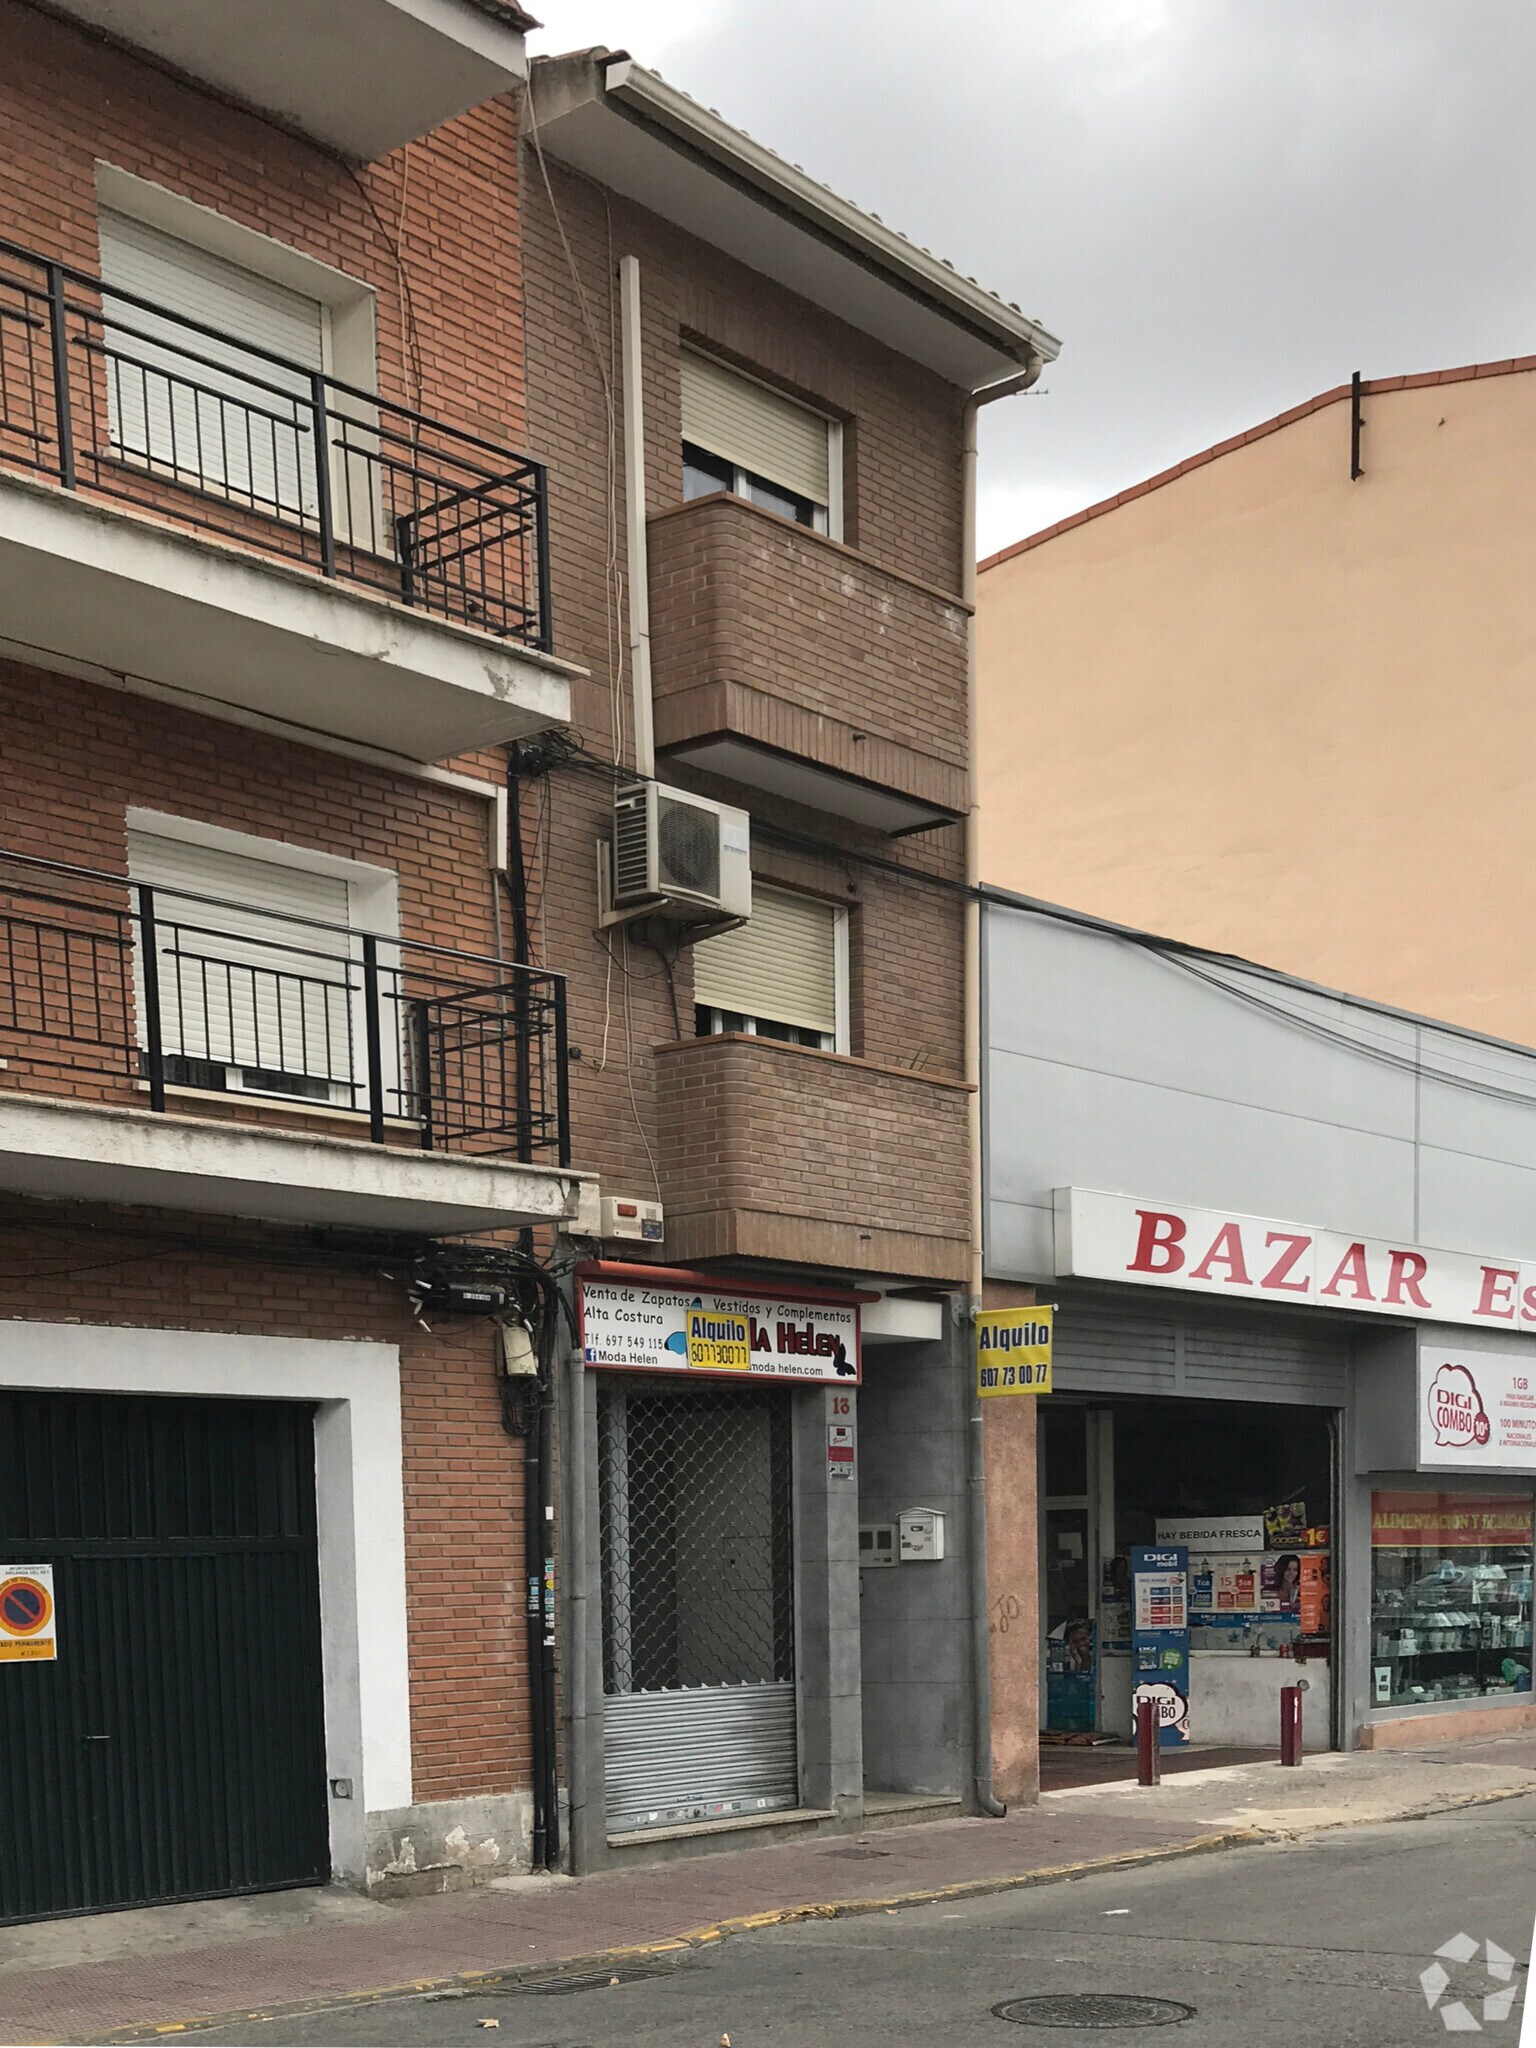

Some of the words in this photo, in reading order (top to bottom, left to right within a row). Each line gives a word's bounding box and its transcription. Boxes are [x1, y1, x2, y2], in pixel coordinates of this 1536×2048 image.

[1126, 1209, 1432, 1309] BAZAR
[583, 1285, 617, 1300] Venta
[621, 1289, 635, 1302] de
[642, 1291, 690, 1309] Zapatos
[584, 1306, 609, 1320] Alta
[615, 1309, 663, 1325] Costura
[713, 1298, 761, 1314] Vestidos
[765, 1306, 772, 1319] y
[777, 1305, 851, 1323] Complementos
[691, 1316, 746, 1342] Alquilo
[980, 1322, 1049, 1352] Alquilo
[606, 1334, 623, 1348] 697
[627, 1336, 645, 1349] 549
[648, 1337, 663, 1350] 115
[599, 1350, 627, 1363] Moda
[630, 1352, 658, 1365] Helen
[778, 1363, 824, 1376] helen.com
[980, 1368, 999, 1388] 607
[1002, 1366, 1015, 1386] 73
[1019, 1365, 1033, 1385] 00
[1036, 1364, 1047, 1383] 77
[1512, 1376, 1528, 1390] 1GB
[1437, 1389, 1471, 1410] DIGI
[1437, 1406, 1472, 1433] COMBO
[1157, 1531, 1178, 1540] HAY
[1179, 1530, 1217, 1539] BEBIDA
[1219, 1528, 1262, 1538] FRESCA
[1143, 1553, 1178, 1561] DIGI
[1220, 1577, 1232, 1586] 15
[1136, 1695, 1176, 1705] DIGI
